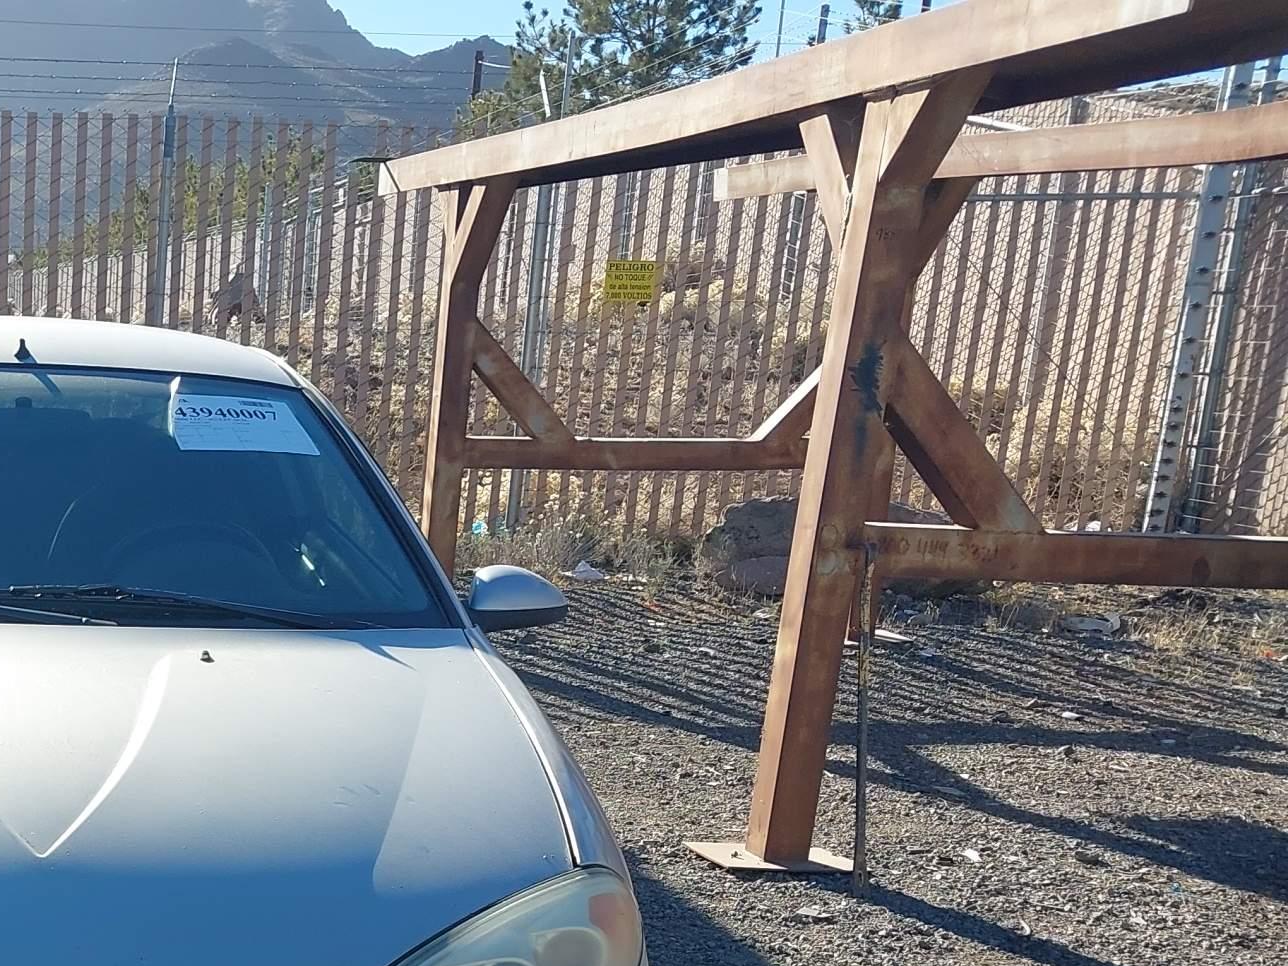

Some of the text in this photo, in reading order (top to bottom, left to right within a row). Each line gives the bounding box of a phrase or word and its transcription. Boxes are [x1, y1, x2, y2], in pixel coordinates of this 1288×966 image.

[609, 262, 655, 272] PELIGRO
[614, 273, 647, 281] NO TOQUE
[623, 291, 652, 300] VOLTIOS
[174, 406, 278, 421] 43940007
